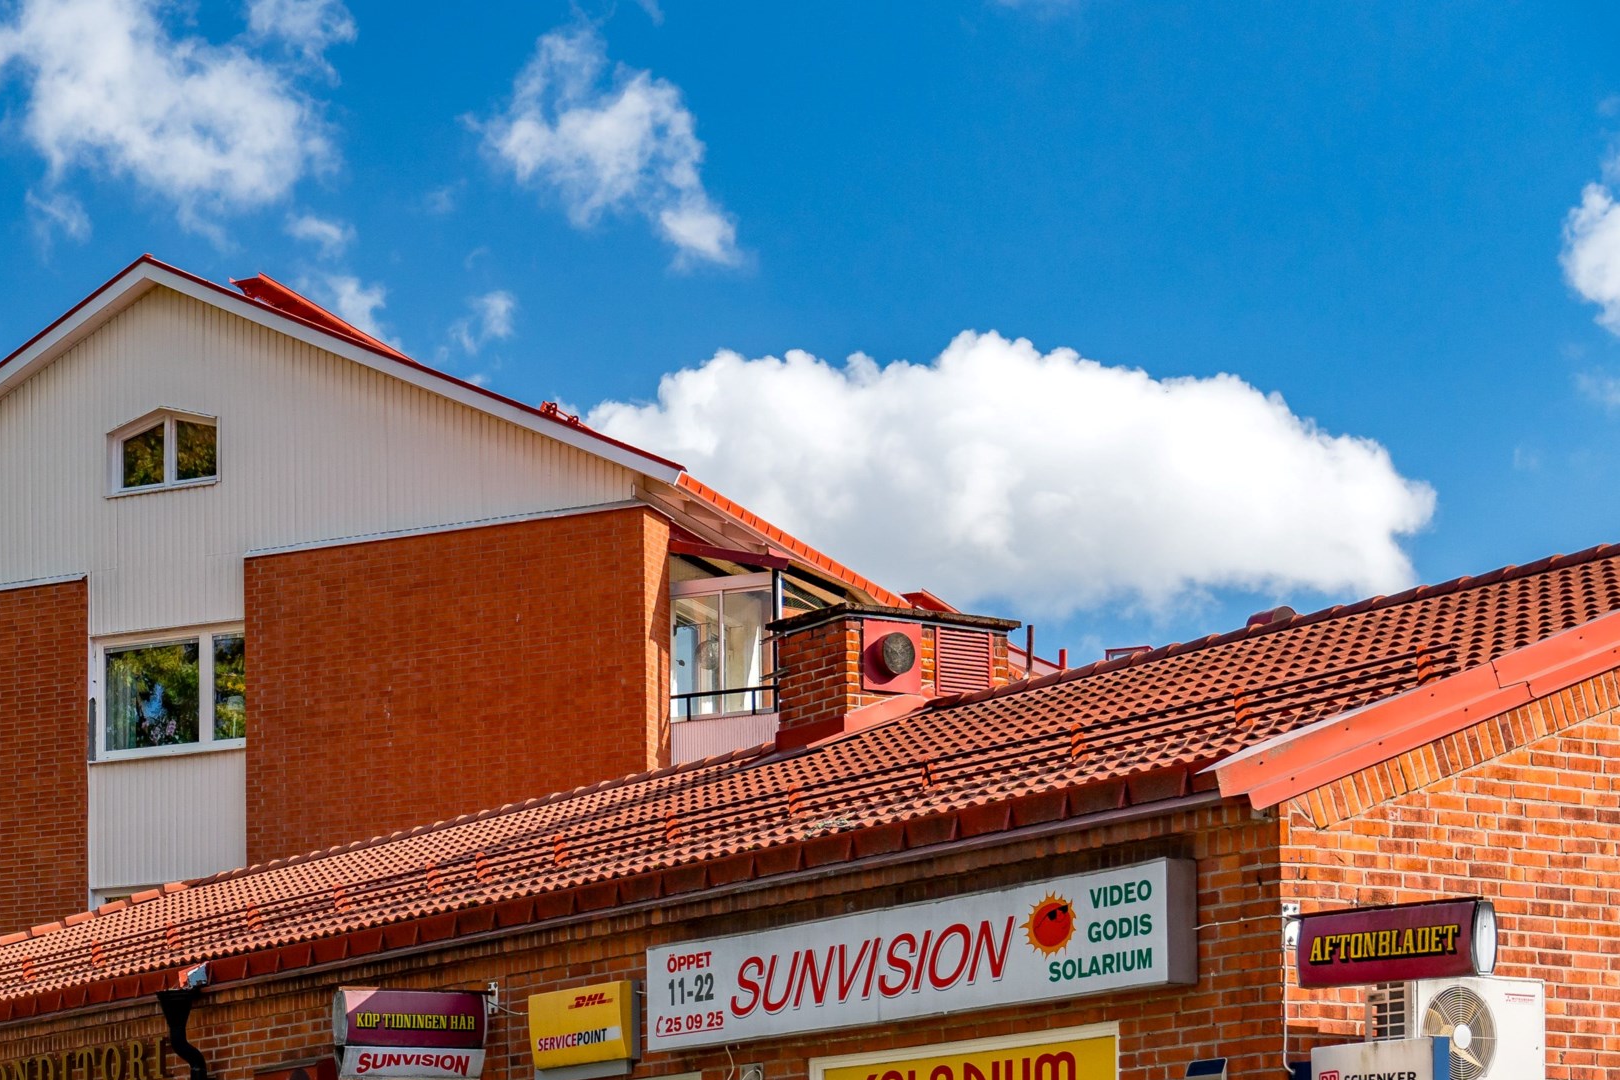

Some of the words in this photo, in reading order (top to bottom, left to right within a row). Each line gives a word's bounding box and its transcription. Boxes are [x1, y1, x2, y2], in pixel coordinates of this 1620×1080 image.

[1089, 879, 1152, 909] VIDEO
[1087, 913, 1152, 943] GODIS
[1309, 923, 1460, 964] AFTONBLADET
[667, 951, 712, 973] ÖPPET
[730, 914, 1017, 1019] SUNVISION
[1048, 947, 1152, 982] SOLARIUM
[573, 992, 608, 1008] DHL
[668, 972, 714, 1006] 11-22
[356, 1011, 380, 1028] KÖP
[383, 1013, 447, 1029] TIDNINGEN
[450, 1014, 475, 1030] HÄR
[665, 1016, 681, 1033] 25
[686, 1013, 702, 1030] 09
[707, 1010, 723, 1027] 25
[538, 1028, 607, 1051] SERVICEPOINT
[356, 1053, 470, 1077] SUNVISION
